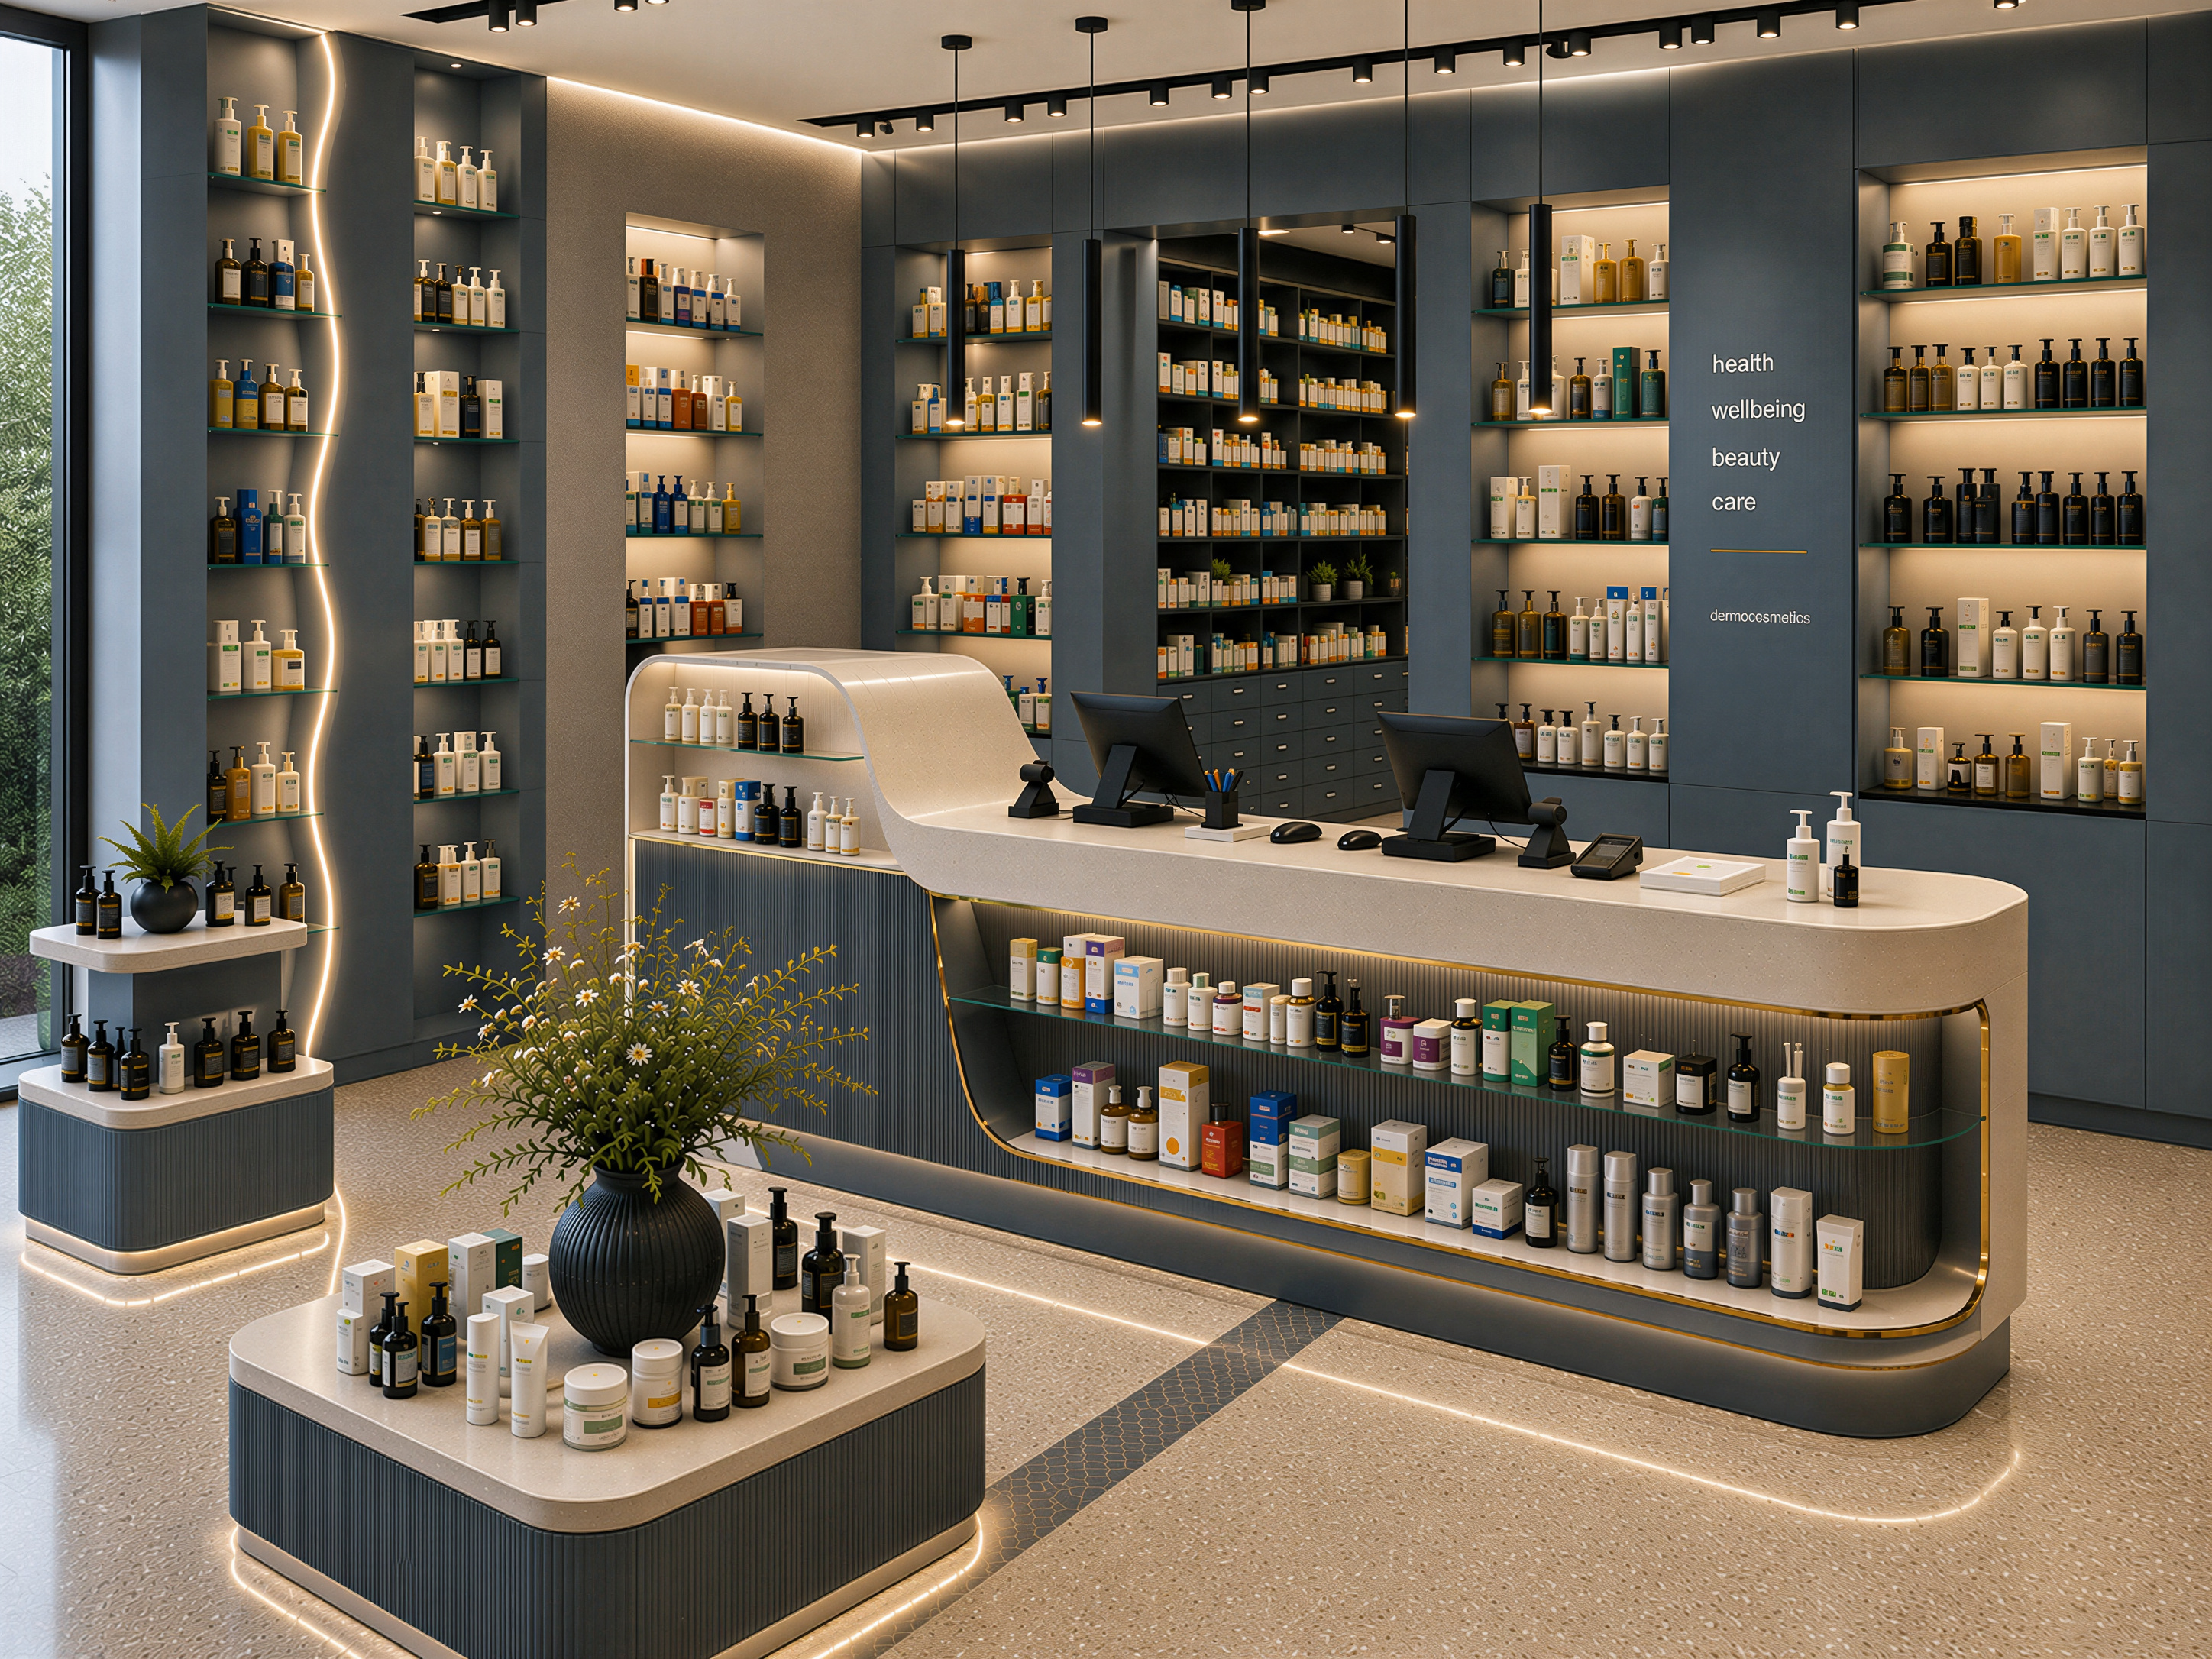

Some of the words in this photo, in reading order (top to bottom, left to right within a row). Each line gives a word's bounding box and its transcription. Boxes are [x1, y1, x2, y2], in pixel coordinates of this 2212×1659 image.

[1712, 353, 1774, 374] health
[1711, 399, 1805, 422] wellbeing
[1712, 448, 1780, 471] beauty
[1712, 496, 1756, 511] care
